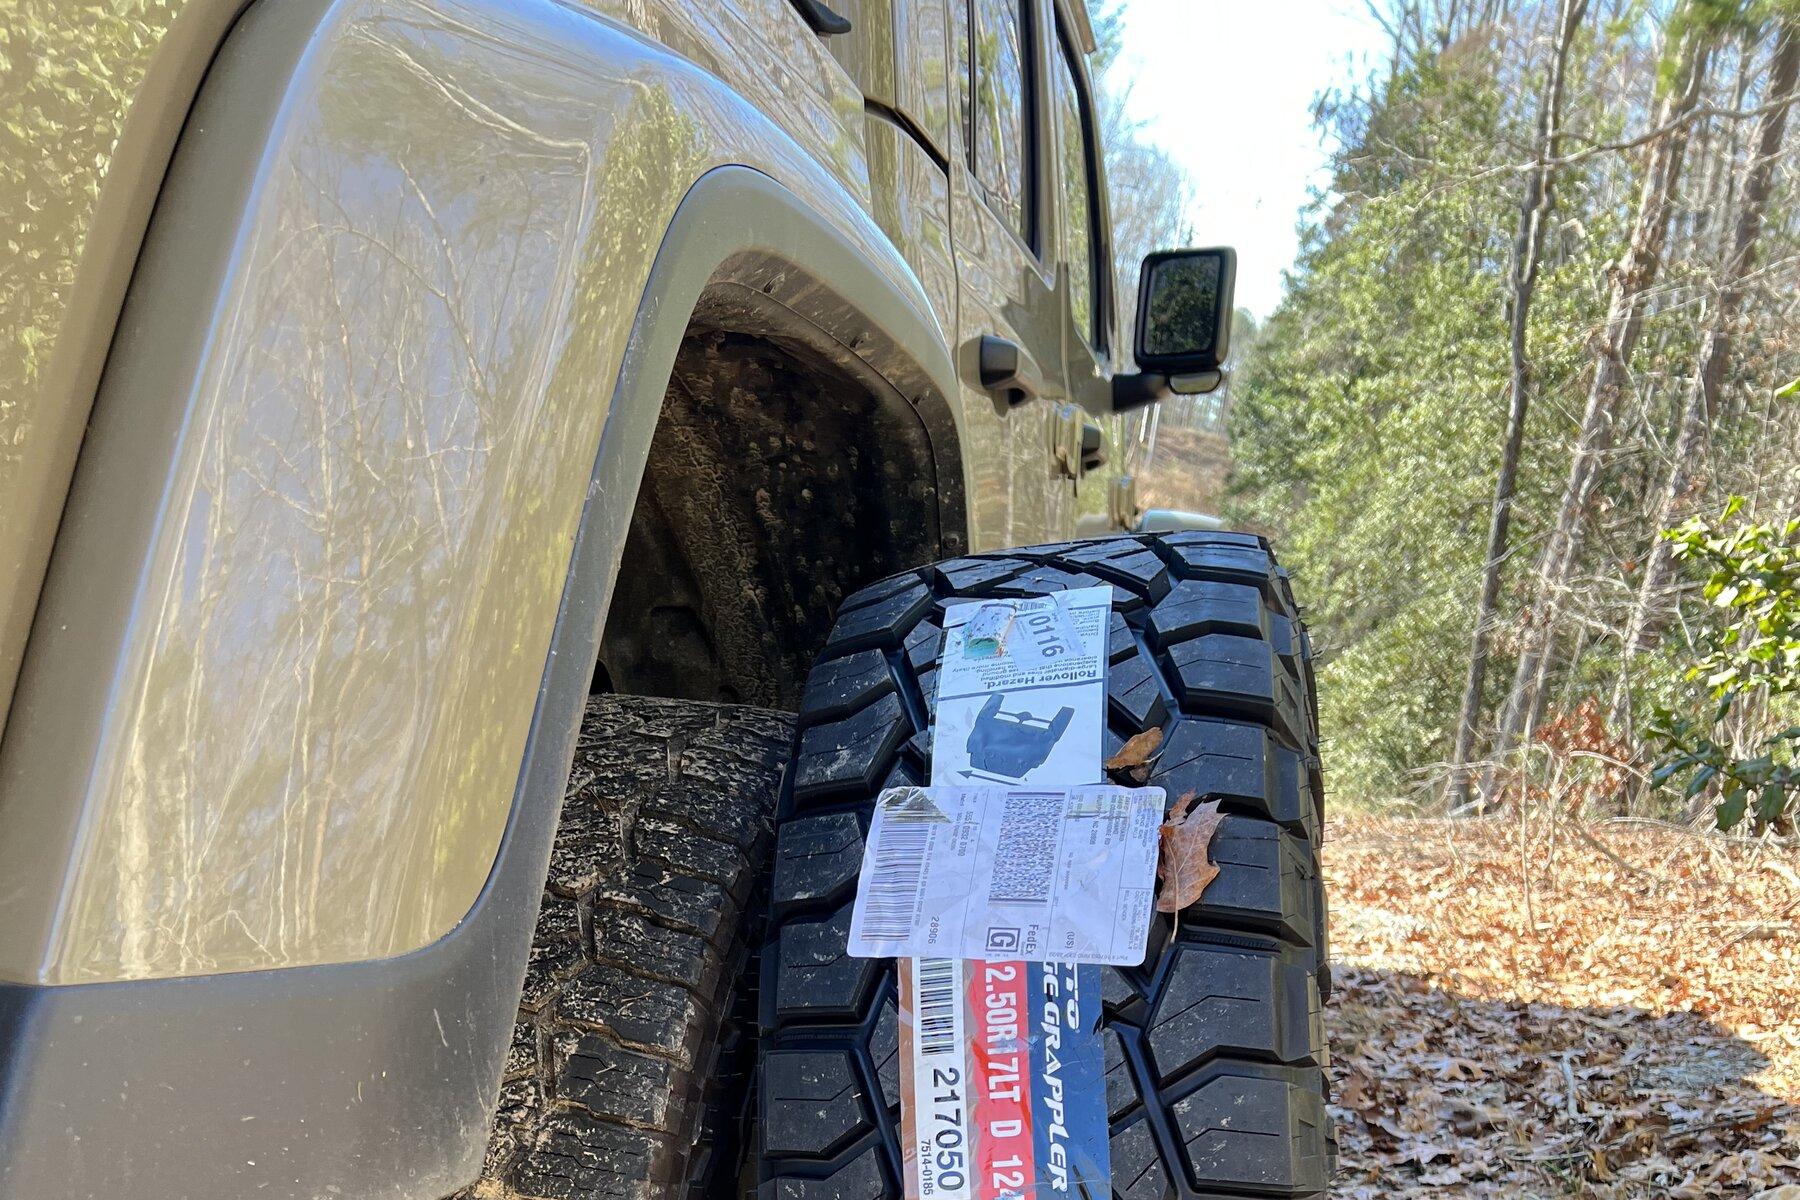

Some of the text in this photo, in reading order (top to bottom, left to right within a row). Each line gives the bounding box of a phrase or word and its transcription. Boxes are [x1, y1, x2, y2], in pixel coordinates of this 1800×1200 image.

[1029, 614, 1065, 658] 0116
[983, 669, 1097, 690] Rollover Hazard.
[928, 915, 940, 945] 28906
[990, 932, 1015, 948] G
[1025, 924, 1039, 955] FedEx
[1065, 931, 1075, 949] (US)
[985, 959, 1022, 1102] 2.50R17LT
[1038, 1001, 1070, 1192] GRAPPLER
[933, 1067, 965, 1192] 217050
[990, 1119, 1022, 1138] D
[920, 1139, 934, 1196] 7514-0185
